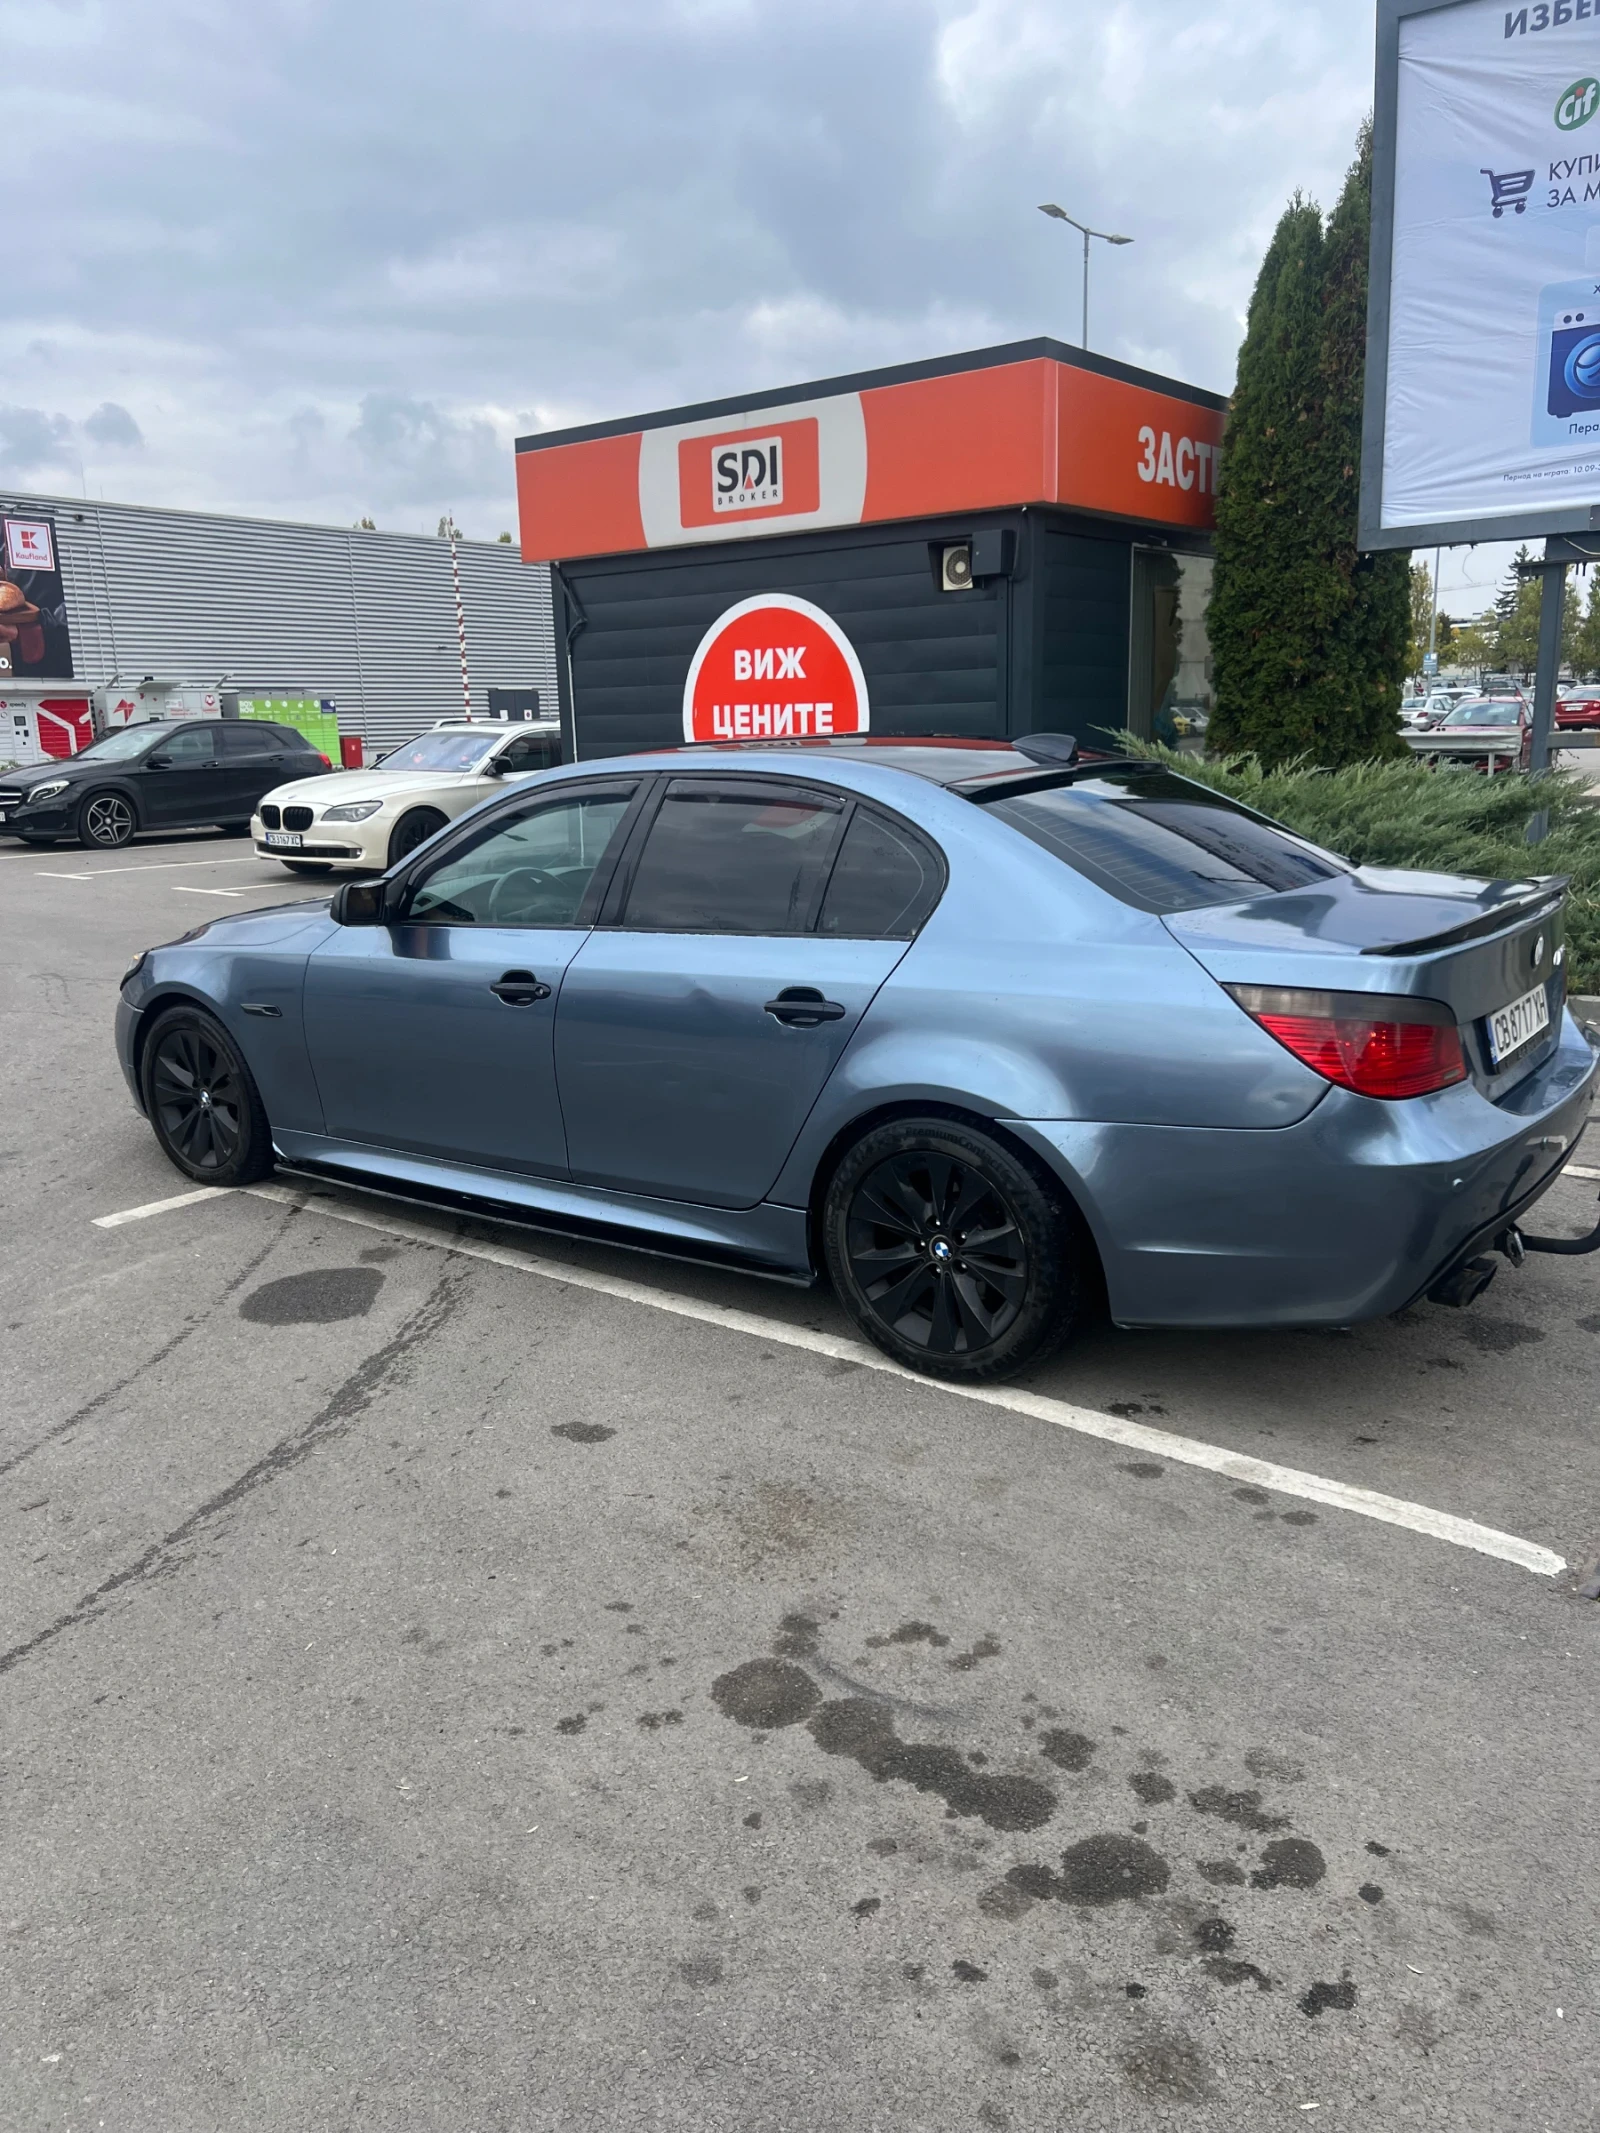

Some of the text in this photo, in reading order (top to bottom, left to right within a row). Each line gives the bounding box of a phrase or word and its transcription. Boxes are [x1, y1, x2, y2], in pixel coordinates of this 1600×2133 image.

[1559, 83, 1596, 126] Cif
[1547, 186, 1577, 208] ЗА
[717, 445, 778, 493] SDI
[1503, 473, 1531, 482] Период
[1574, 464, 1600, 474] 10.09-
[717, 489, 778, 505] BROKER
[15, 551, 48, 562] Kaufland
[734, 647, 807, 681] ВИЖ
[712, 702, 834, 739] ЦЕНИТЕ
